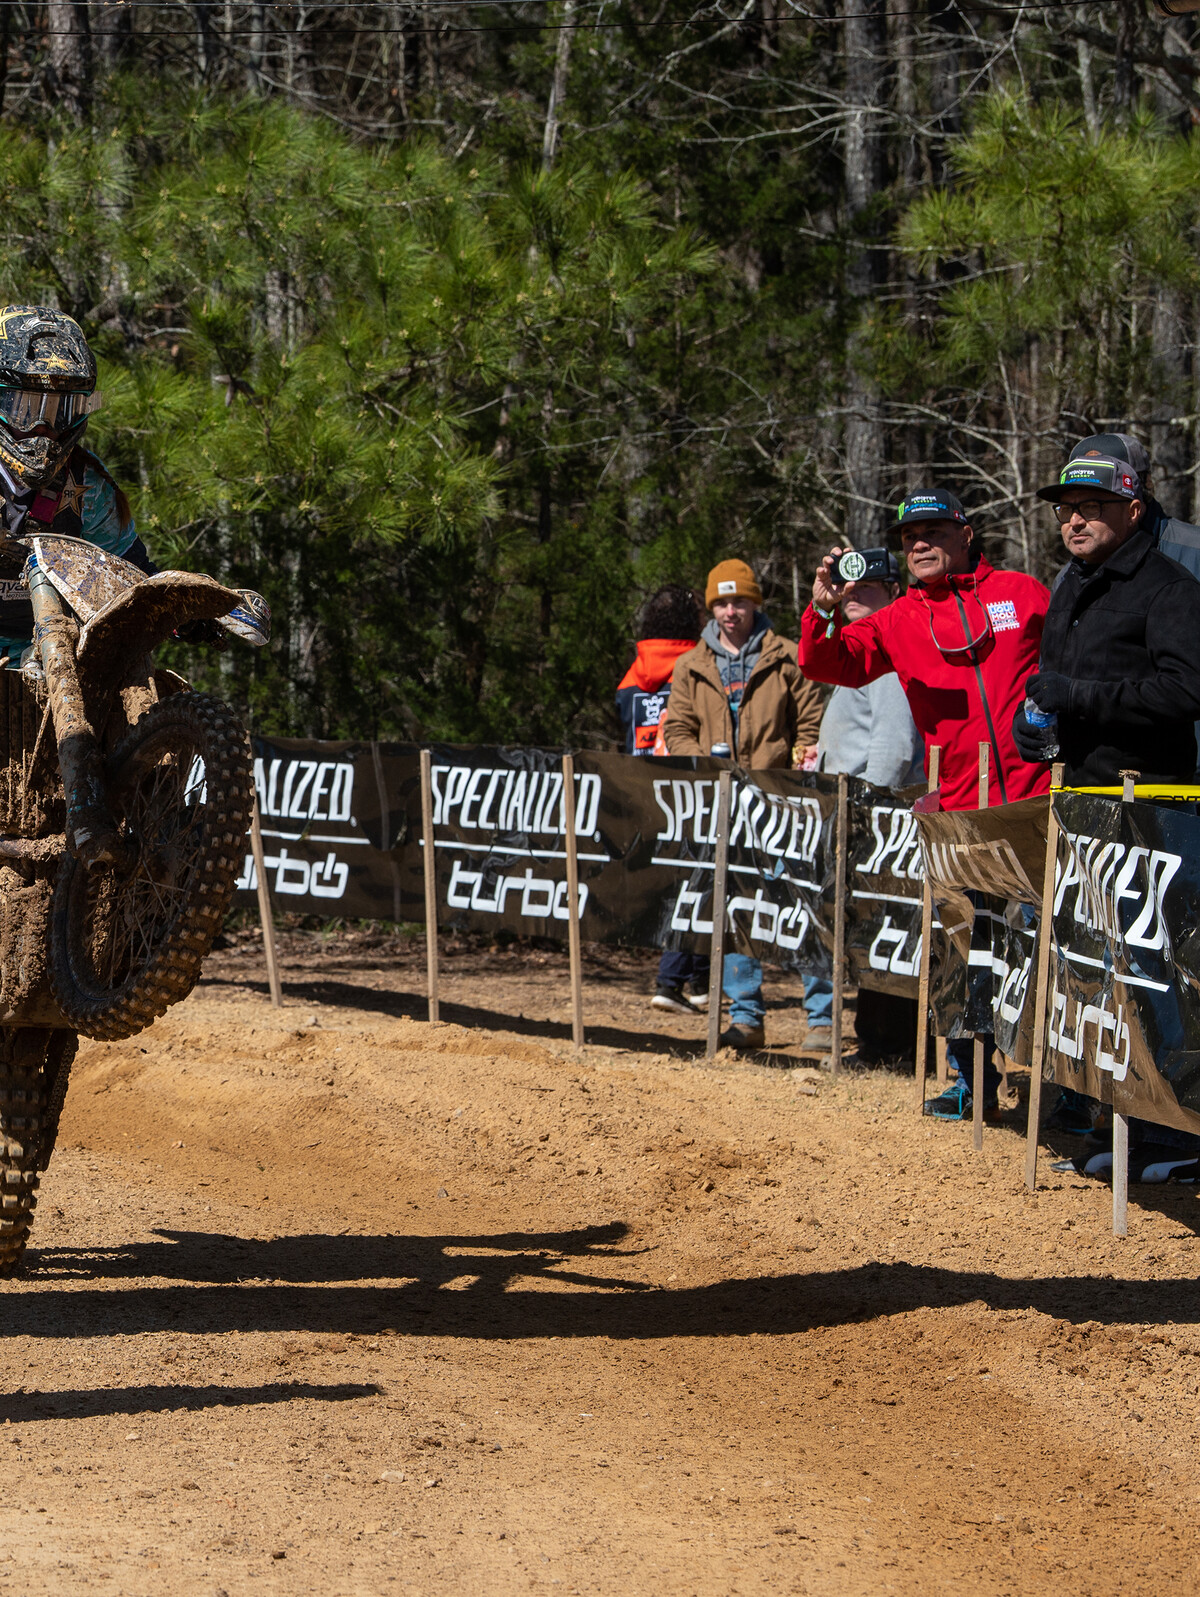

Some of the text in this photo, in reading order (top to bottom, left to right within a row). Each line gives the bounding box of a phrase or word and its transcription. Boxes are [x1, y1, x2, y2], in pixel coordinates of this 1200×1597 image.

[254, 757, 354, 822] ALIZED
[234, 848, 349, 899] rbo
[447, 860, 589, 920] turbo
